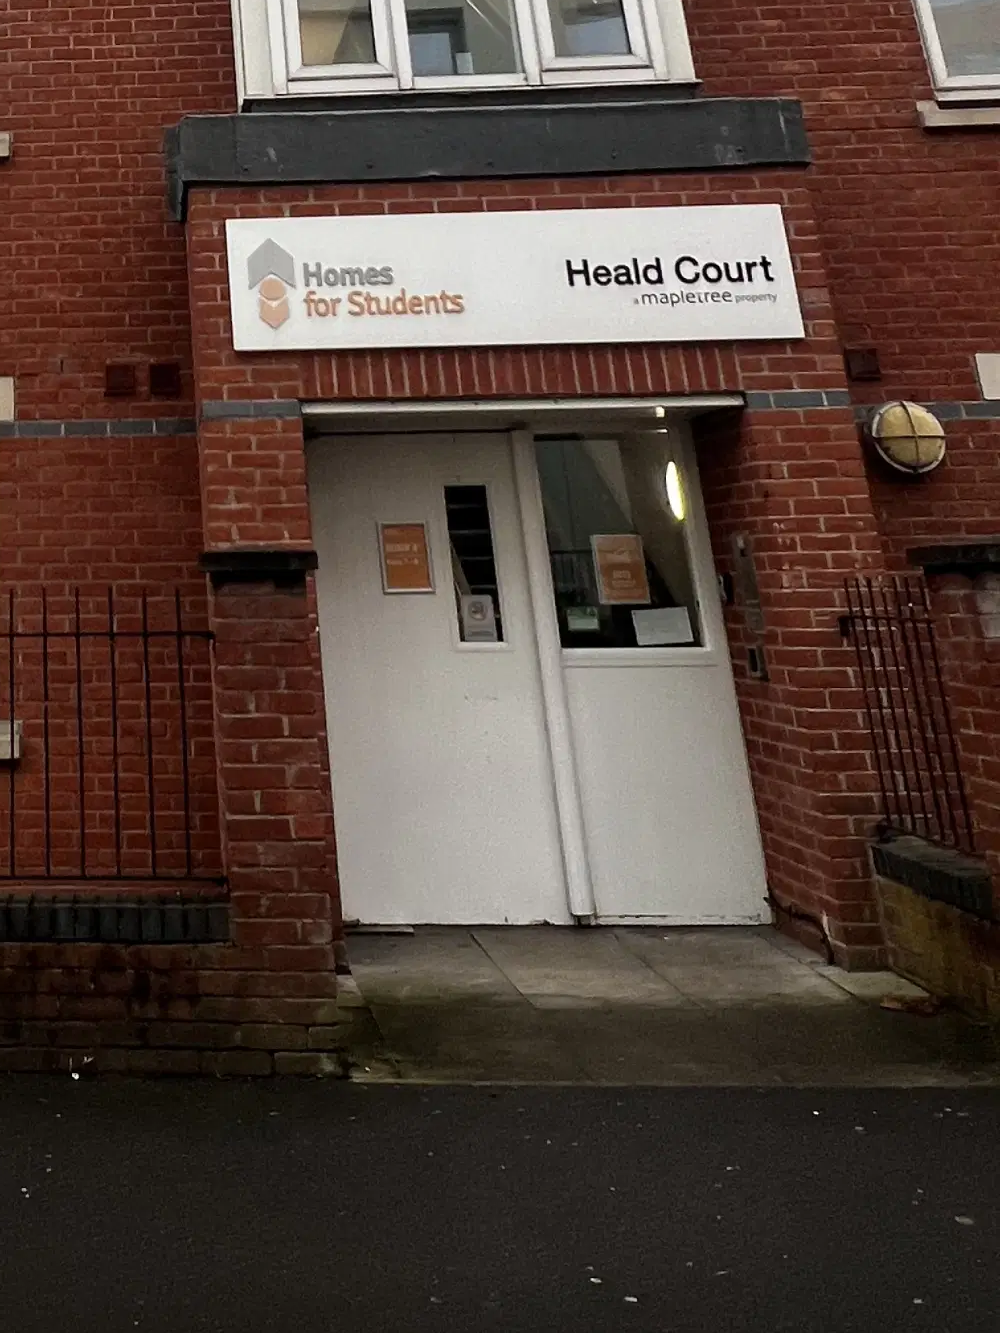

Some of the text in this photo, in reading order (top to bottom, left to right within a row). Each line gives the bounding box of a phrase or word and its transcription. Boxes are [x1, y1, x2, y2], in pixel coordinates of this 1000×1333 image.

[302, 262, 394, 287] Homes
[565, 255, 775, 287] Heald Court
[302, 287, 466, 317] for Students
[641, 290, 734, 307] mapletree
[735, 293, 778, 304] property
